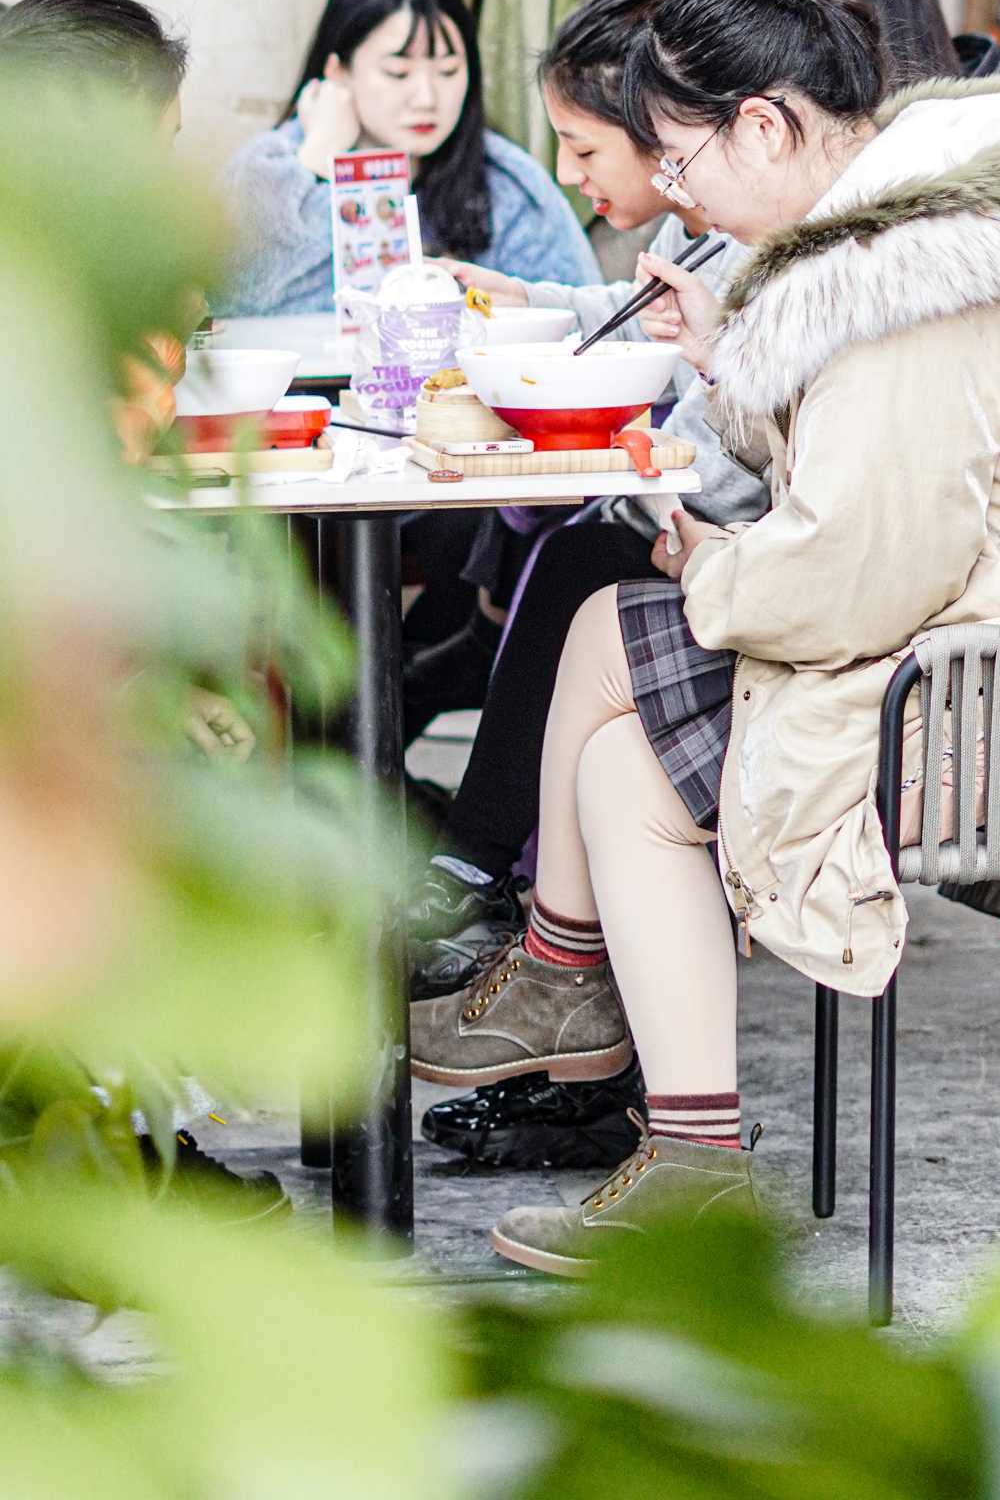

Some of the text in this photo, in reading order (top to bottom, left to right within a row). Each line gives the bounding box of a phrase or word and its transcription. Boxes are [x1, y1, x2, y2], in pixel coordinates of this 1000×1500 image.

[410, 327, 439, 338] THE
[397, 339, 451, 351] YOGURT
[408, 350, 441, 361] COW
[372, 366, 410, 379] THE
[355, 376, 430, 394] YOGUR
